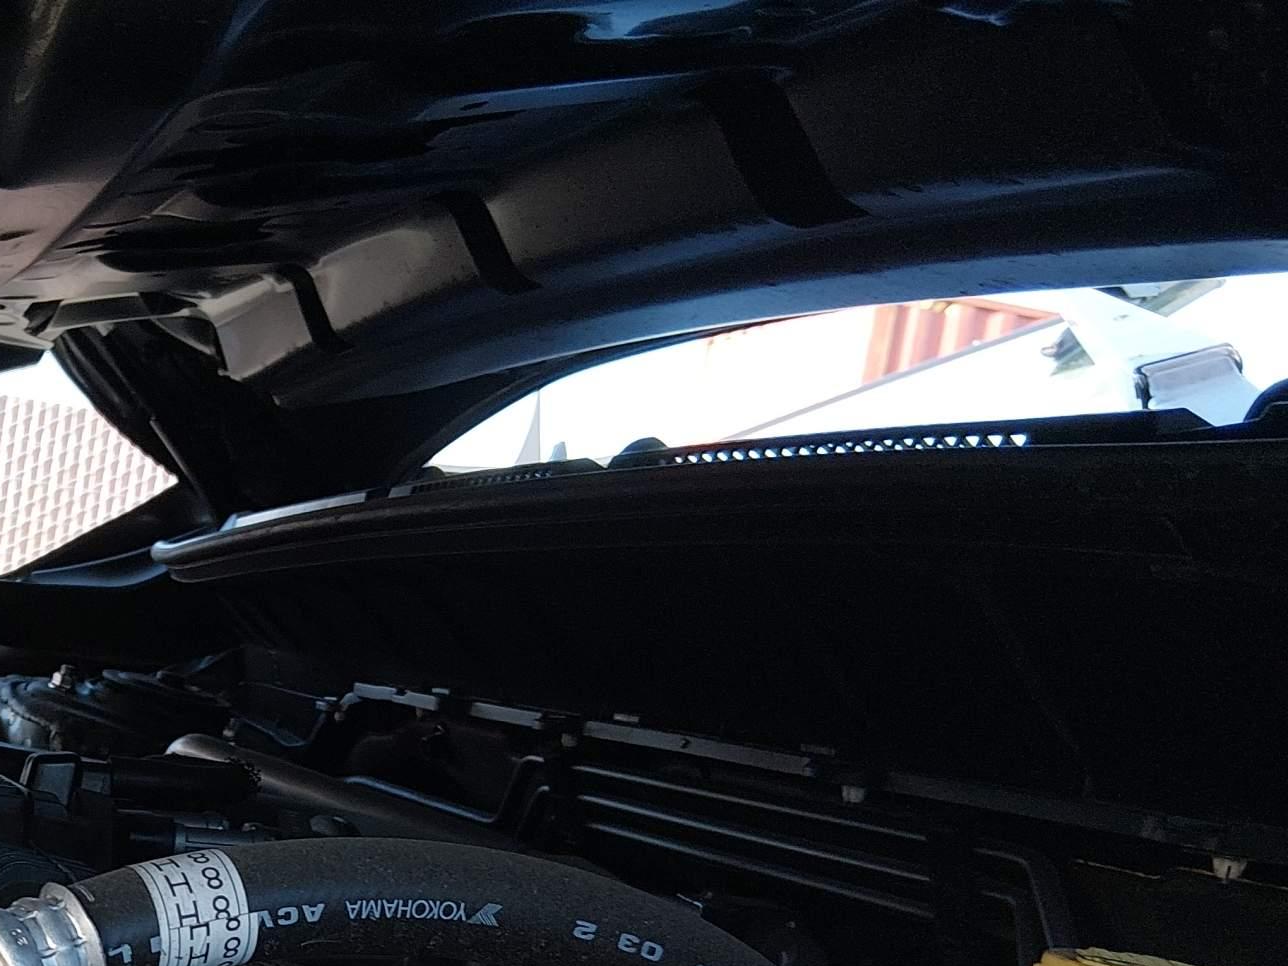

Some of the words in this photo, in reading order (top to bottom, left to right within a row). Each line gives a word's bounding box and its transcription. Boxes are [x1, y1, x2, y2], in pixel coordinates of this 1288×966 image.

[259, 903, 326, 928] ACV
[345, 898, 468, 922] YOKOHAMA
[572, 919, 599, 941] 2
